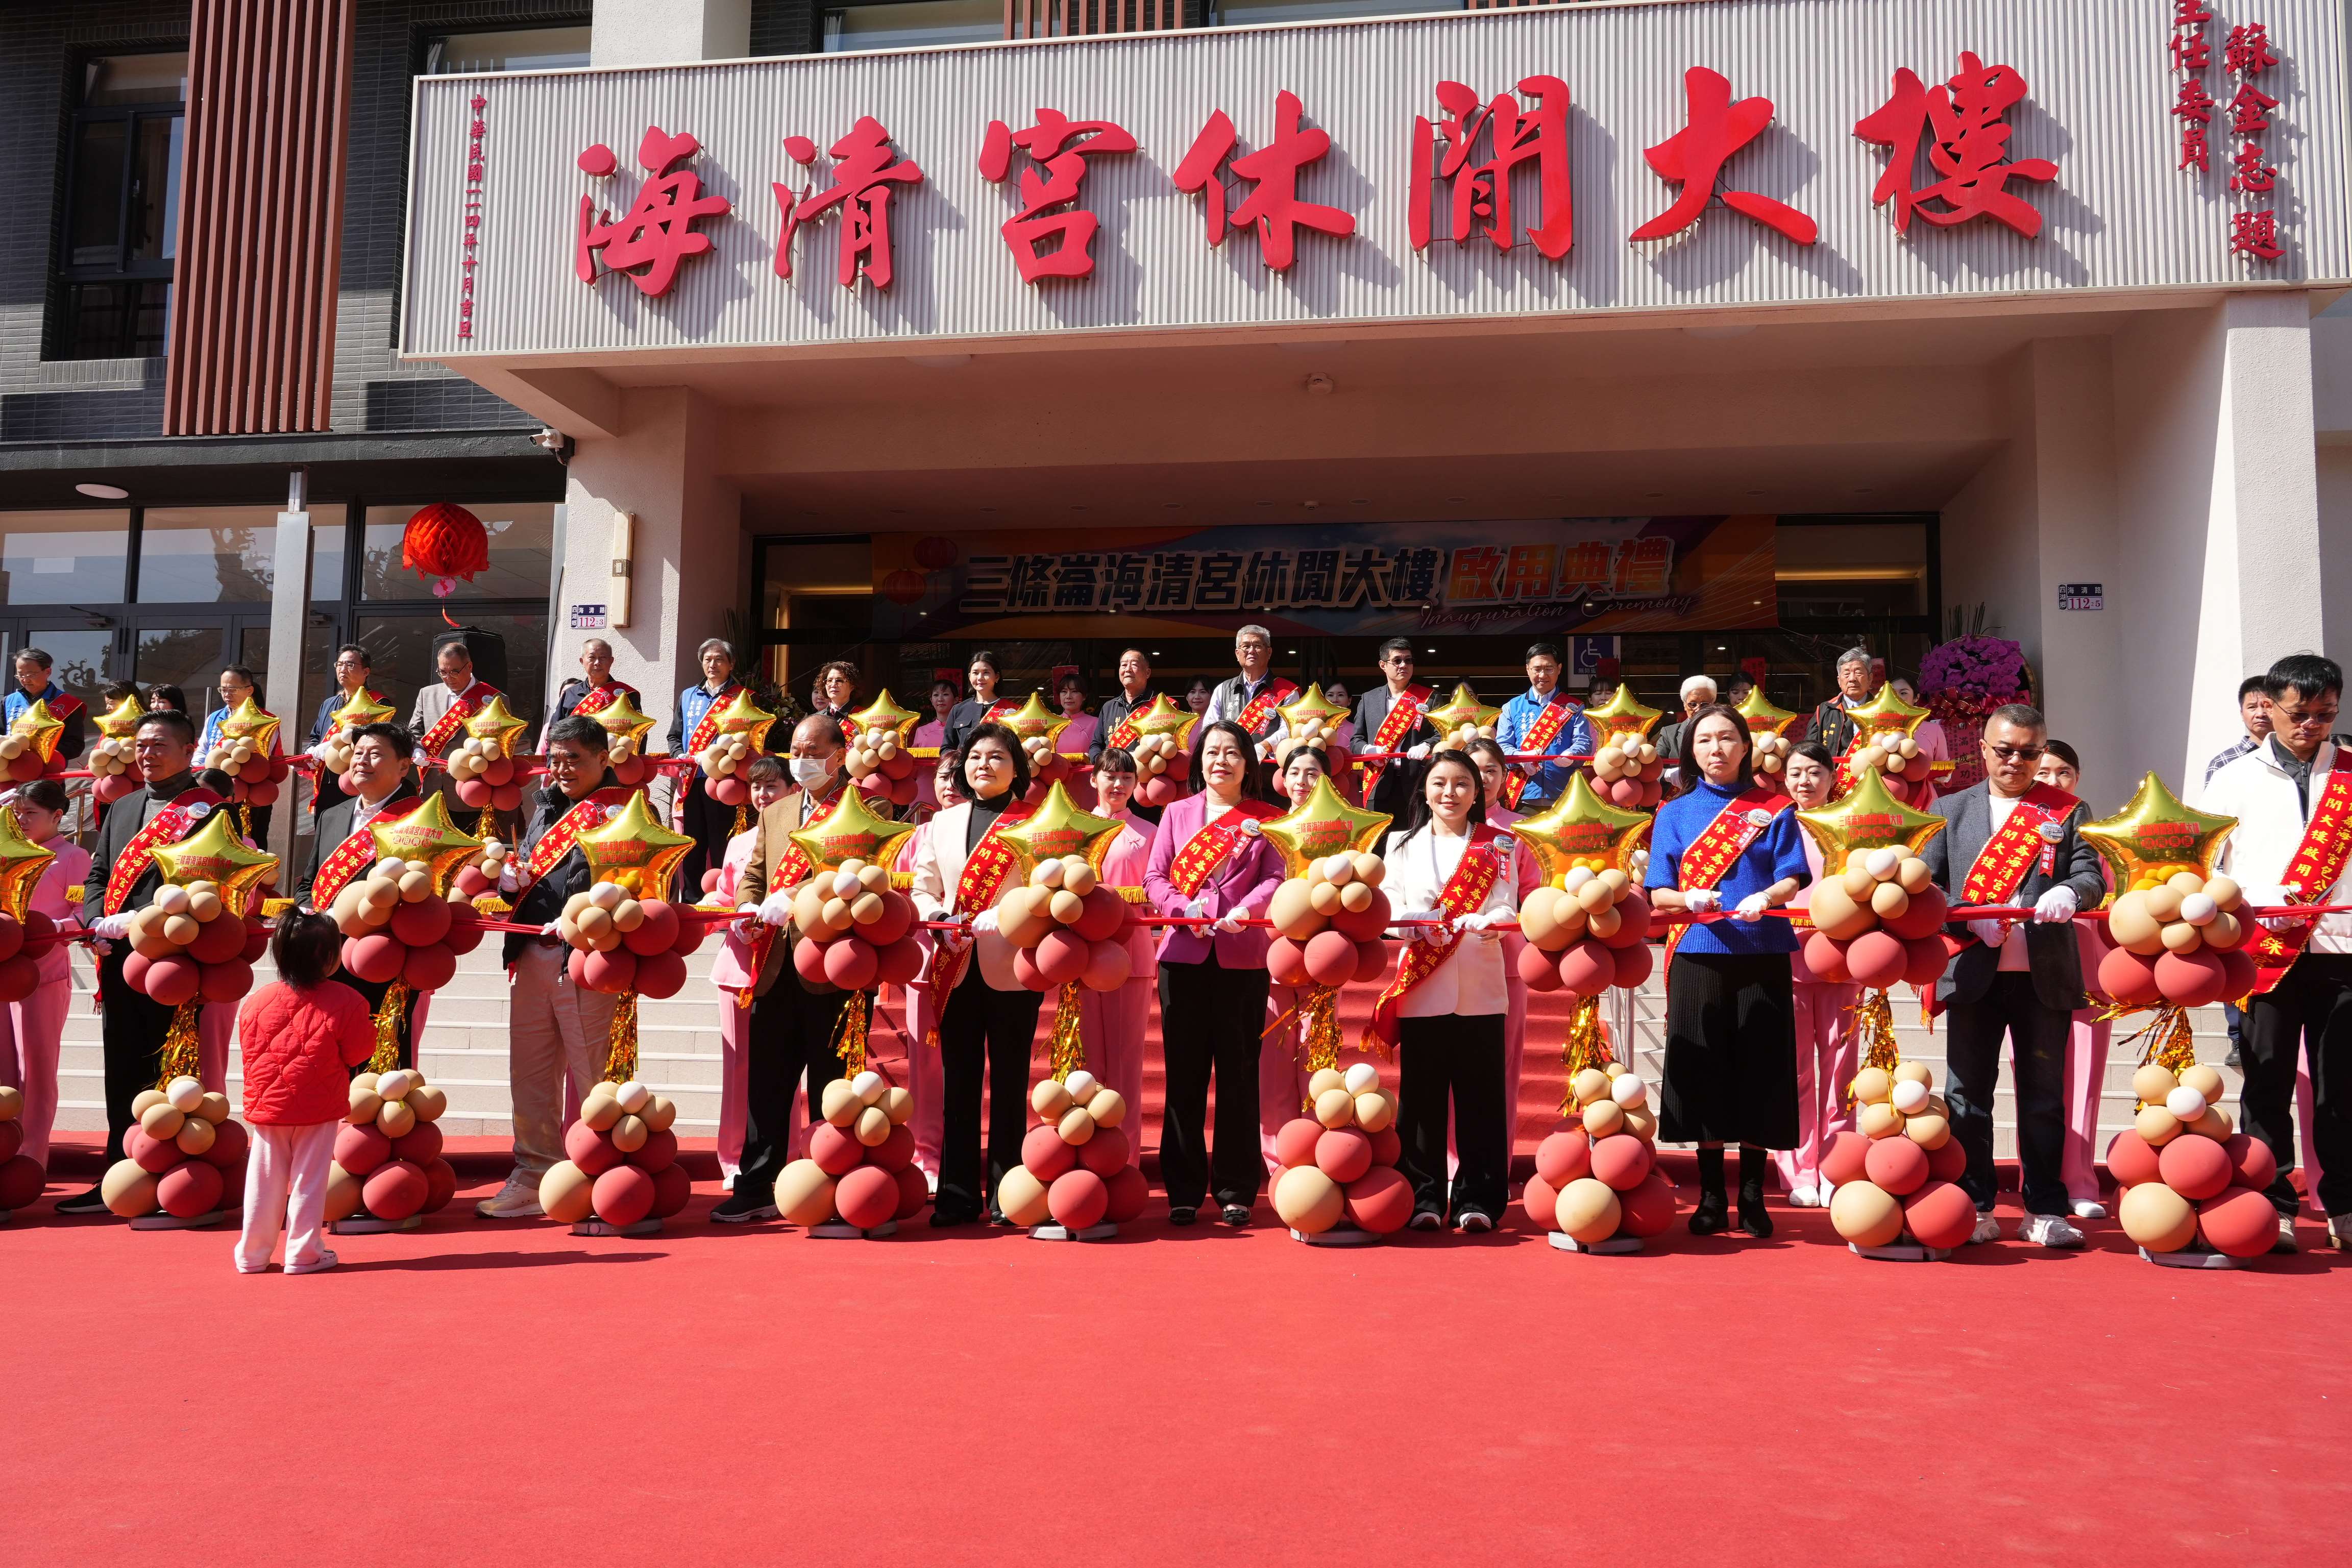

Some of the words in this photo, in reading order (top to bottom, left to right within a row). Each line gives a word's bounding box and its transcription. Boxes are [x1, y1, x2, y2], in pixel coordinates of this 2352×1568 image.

[576, 51, 2057, 298] 海清宮休閒大樓
[2224, 22, 2286, 260] 蘇金志題
[1420, 600, 1568, 631] Inauguration
[1581, 590, 1697, 617] Ceremony
[107, 828, 171, 915] 三條崙海清宮包公
[1173, 832, 1212, 883] 休閒大樓
[1181, 842, 1224, 894] 三條崙海清
[1441, 856, 1479, 912] 休閒大樓
[1968, 815, 2025, 902] 休閒大樓啟用
